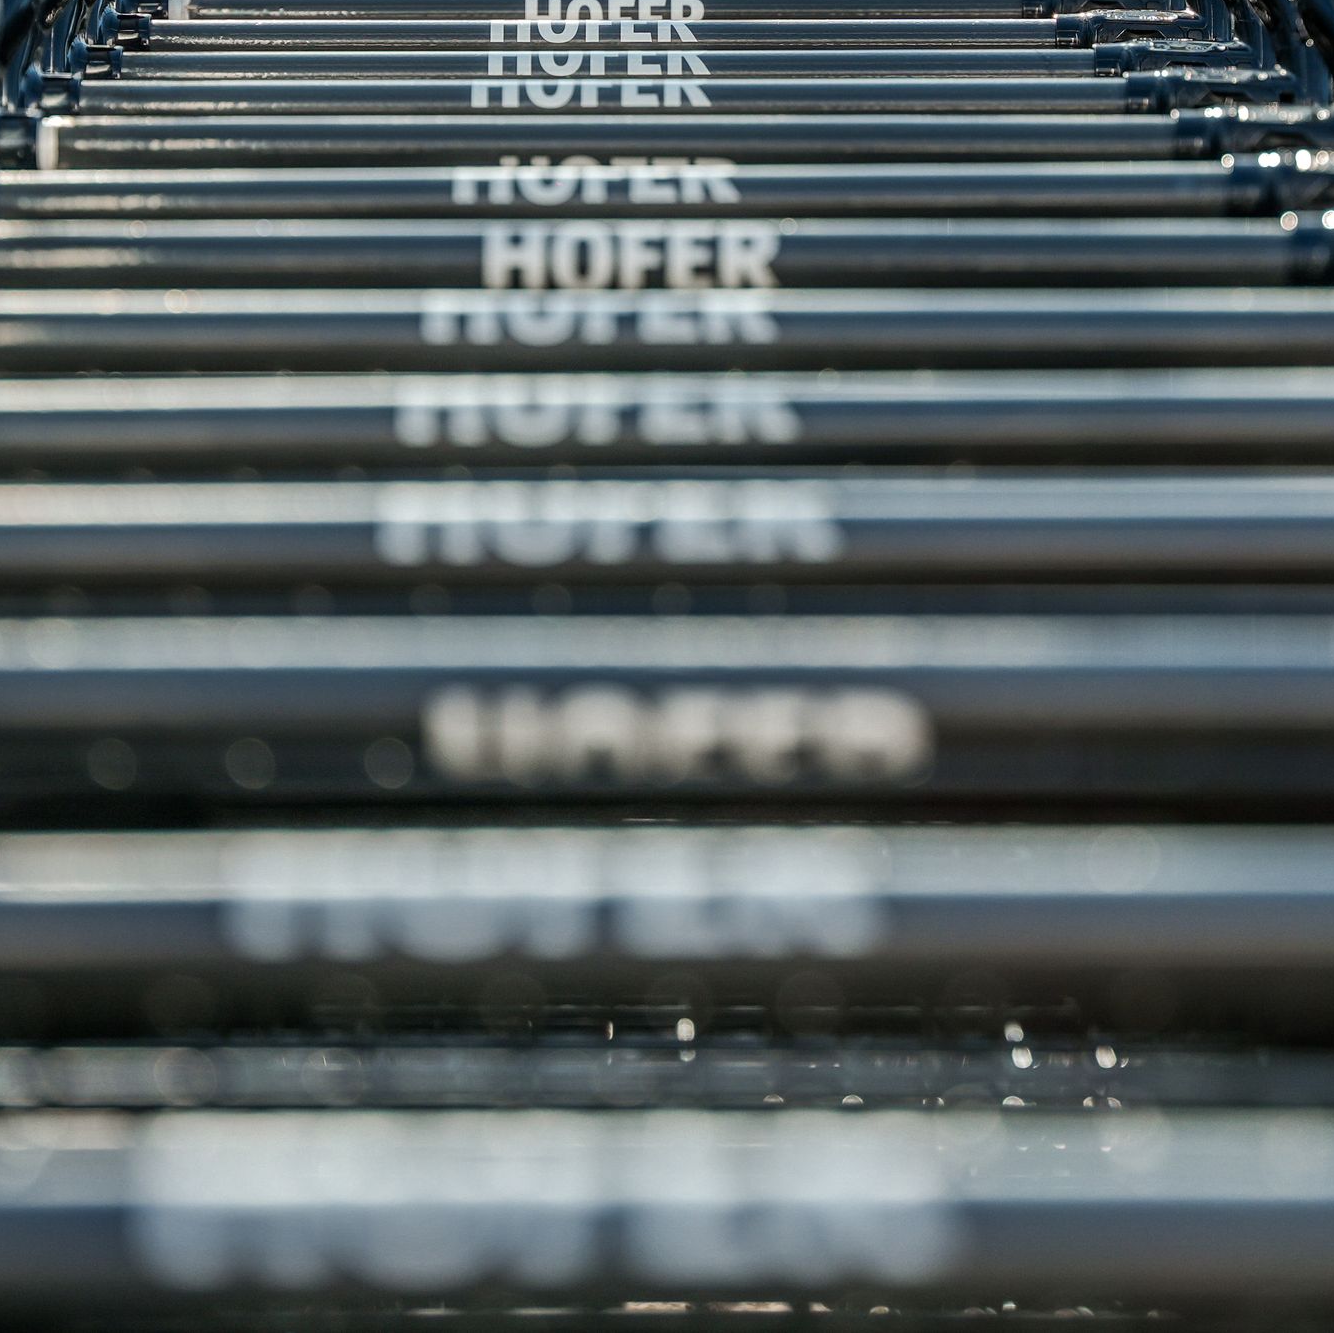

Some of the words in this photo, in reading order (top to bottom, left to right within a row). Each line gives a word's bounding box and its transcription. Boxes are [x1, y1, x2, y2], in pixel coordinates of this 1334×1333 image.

[488, 51, 711, 75] HOFER
[470, 79, 712, 108] HOFER
[481, 219, 781, 288] HOFER
